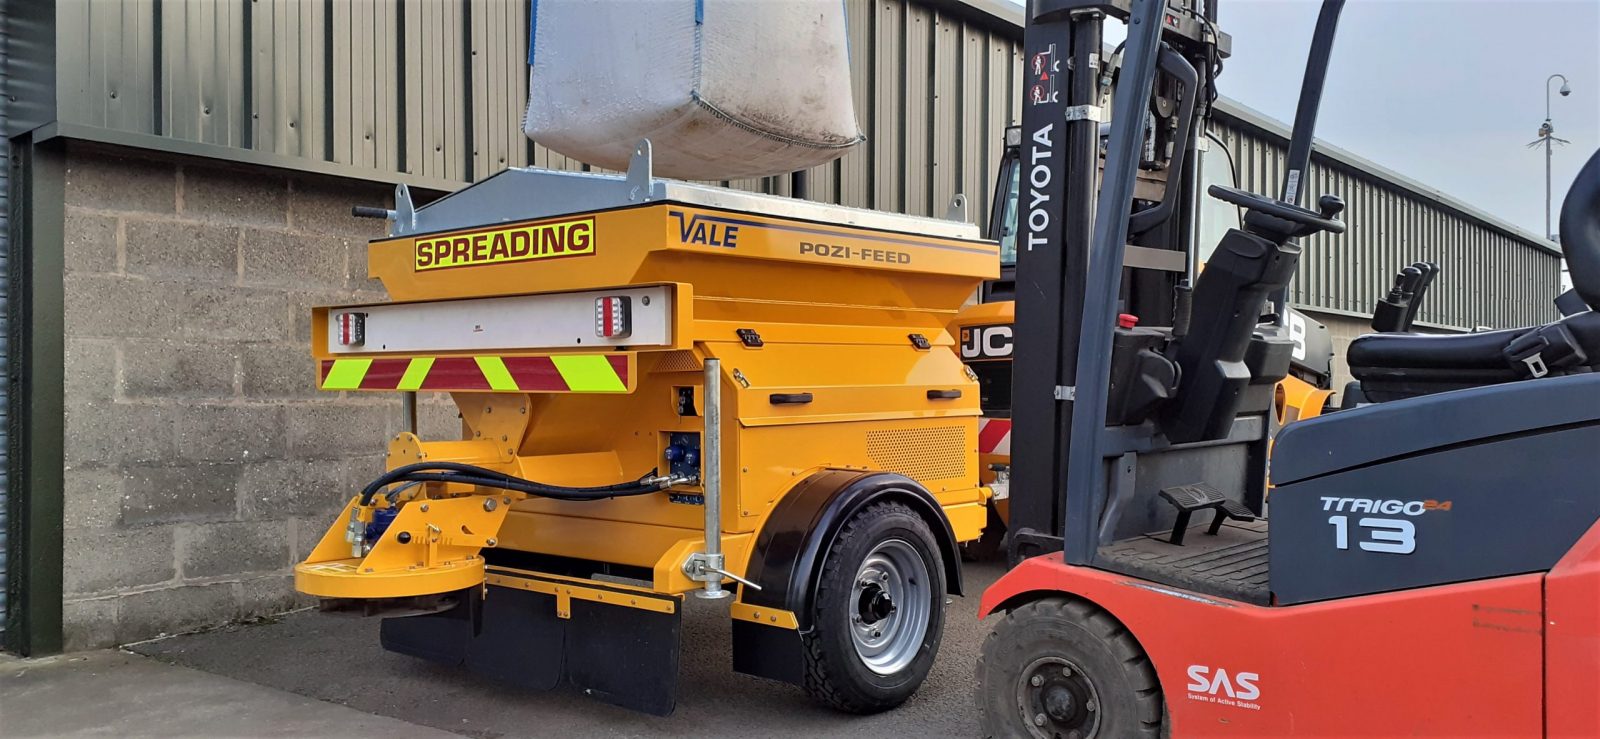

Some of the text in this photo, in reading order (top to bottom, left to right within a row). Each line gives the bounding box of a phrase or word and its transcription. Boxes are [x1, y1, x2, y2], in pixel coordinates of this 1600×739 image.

[1027, 123, 1054, 251] TOYOTA
[417, 222, 590, 267] SPREADING
[669, 210, 739, 248] VALE
[799, 241, 911, 265] POZI-FEED
[961, 326, 1014, 358] JC
[1328, 515, 1416, 554] 13
[1187, 664, 1261, 700] SAS
[1187, 692, 1209, 703] System
[1217, 698, 1236, 707] Active
[1236, 700, 1261, 711] Stability
